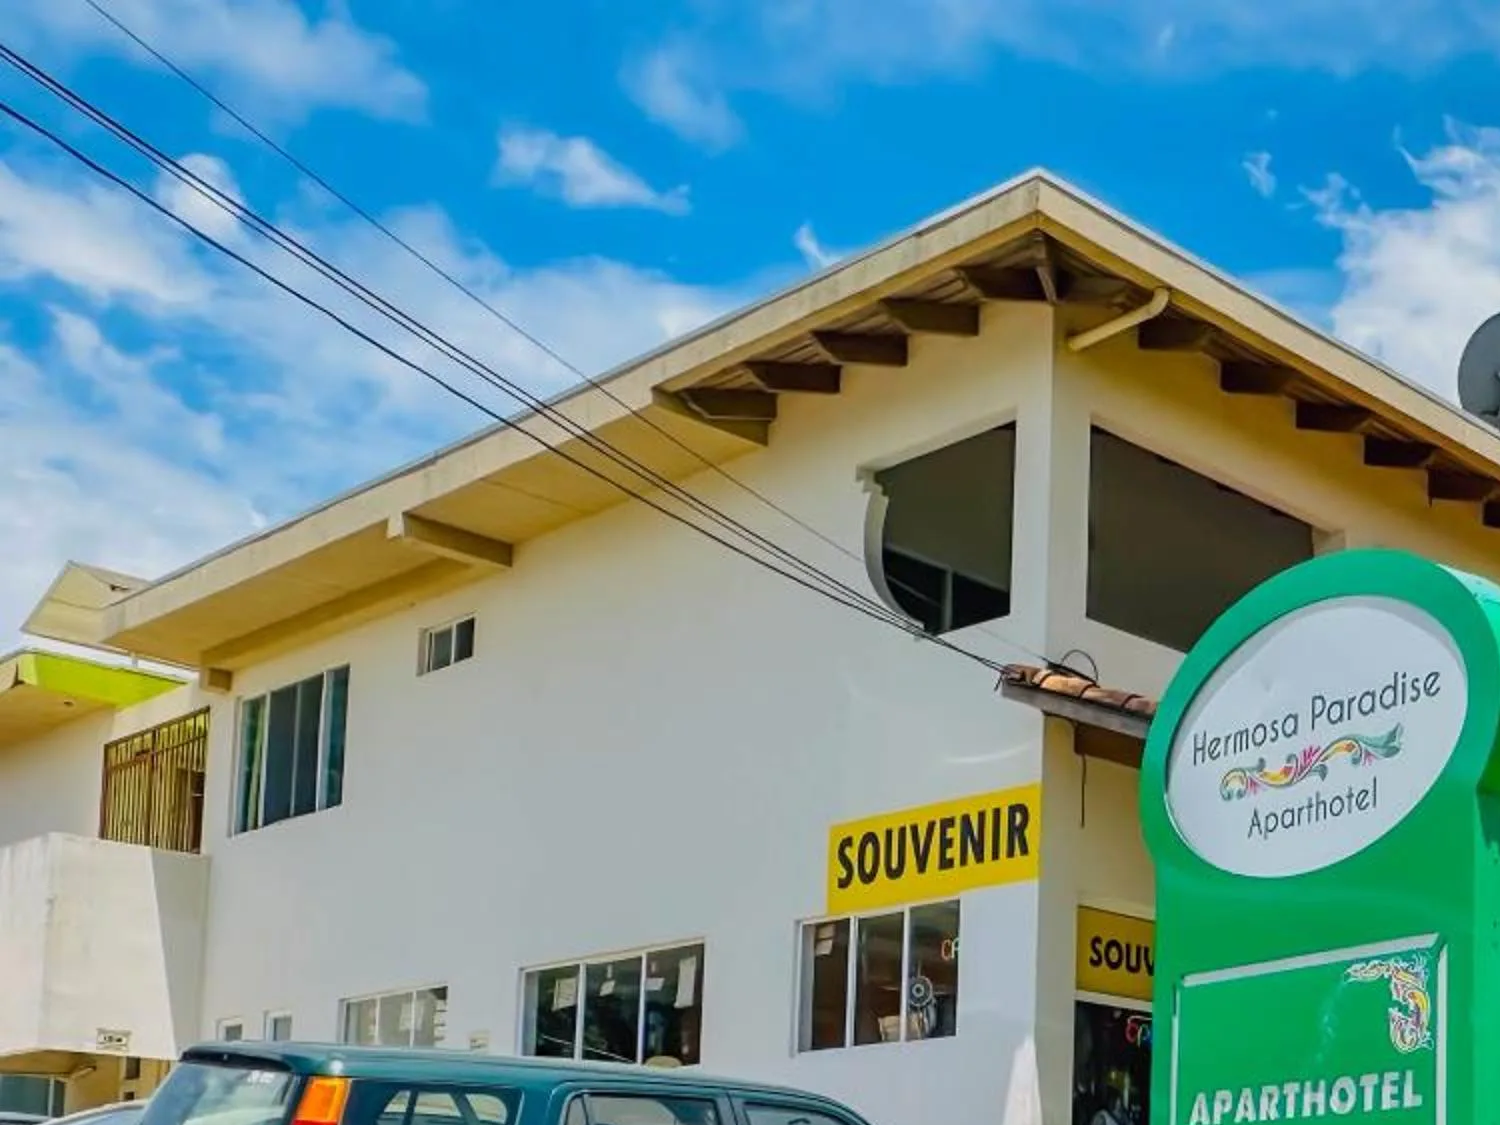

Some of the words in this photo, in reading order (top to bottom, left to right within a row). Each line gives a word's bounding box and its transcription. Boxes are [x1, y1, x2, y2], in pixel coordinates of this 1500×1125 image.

[1193, 712, 1300, 767] Hermosa
[1311, 671, 1442, 731] Paradise
[1247, 776, 1378, 840] Aparthotel
[837, 803, 1030, 889] SOUVENIR
[1088, 935, 1154, 977] SOUV
